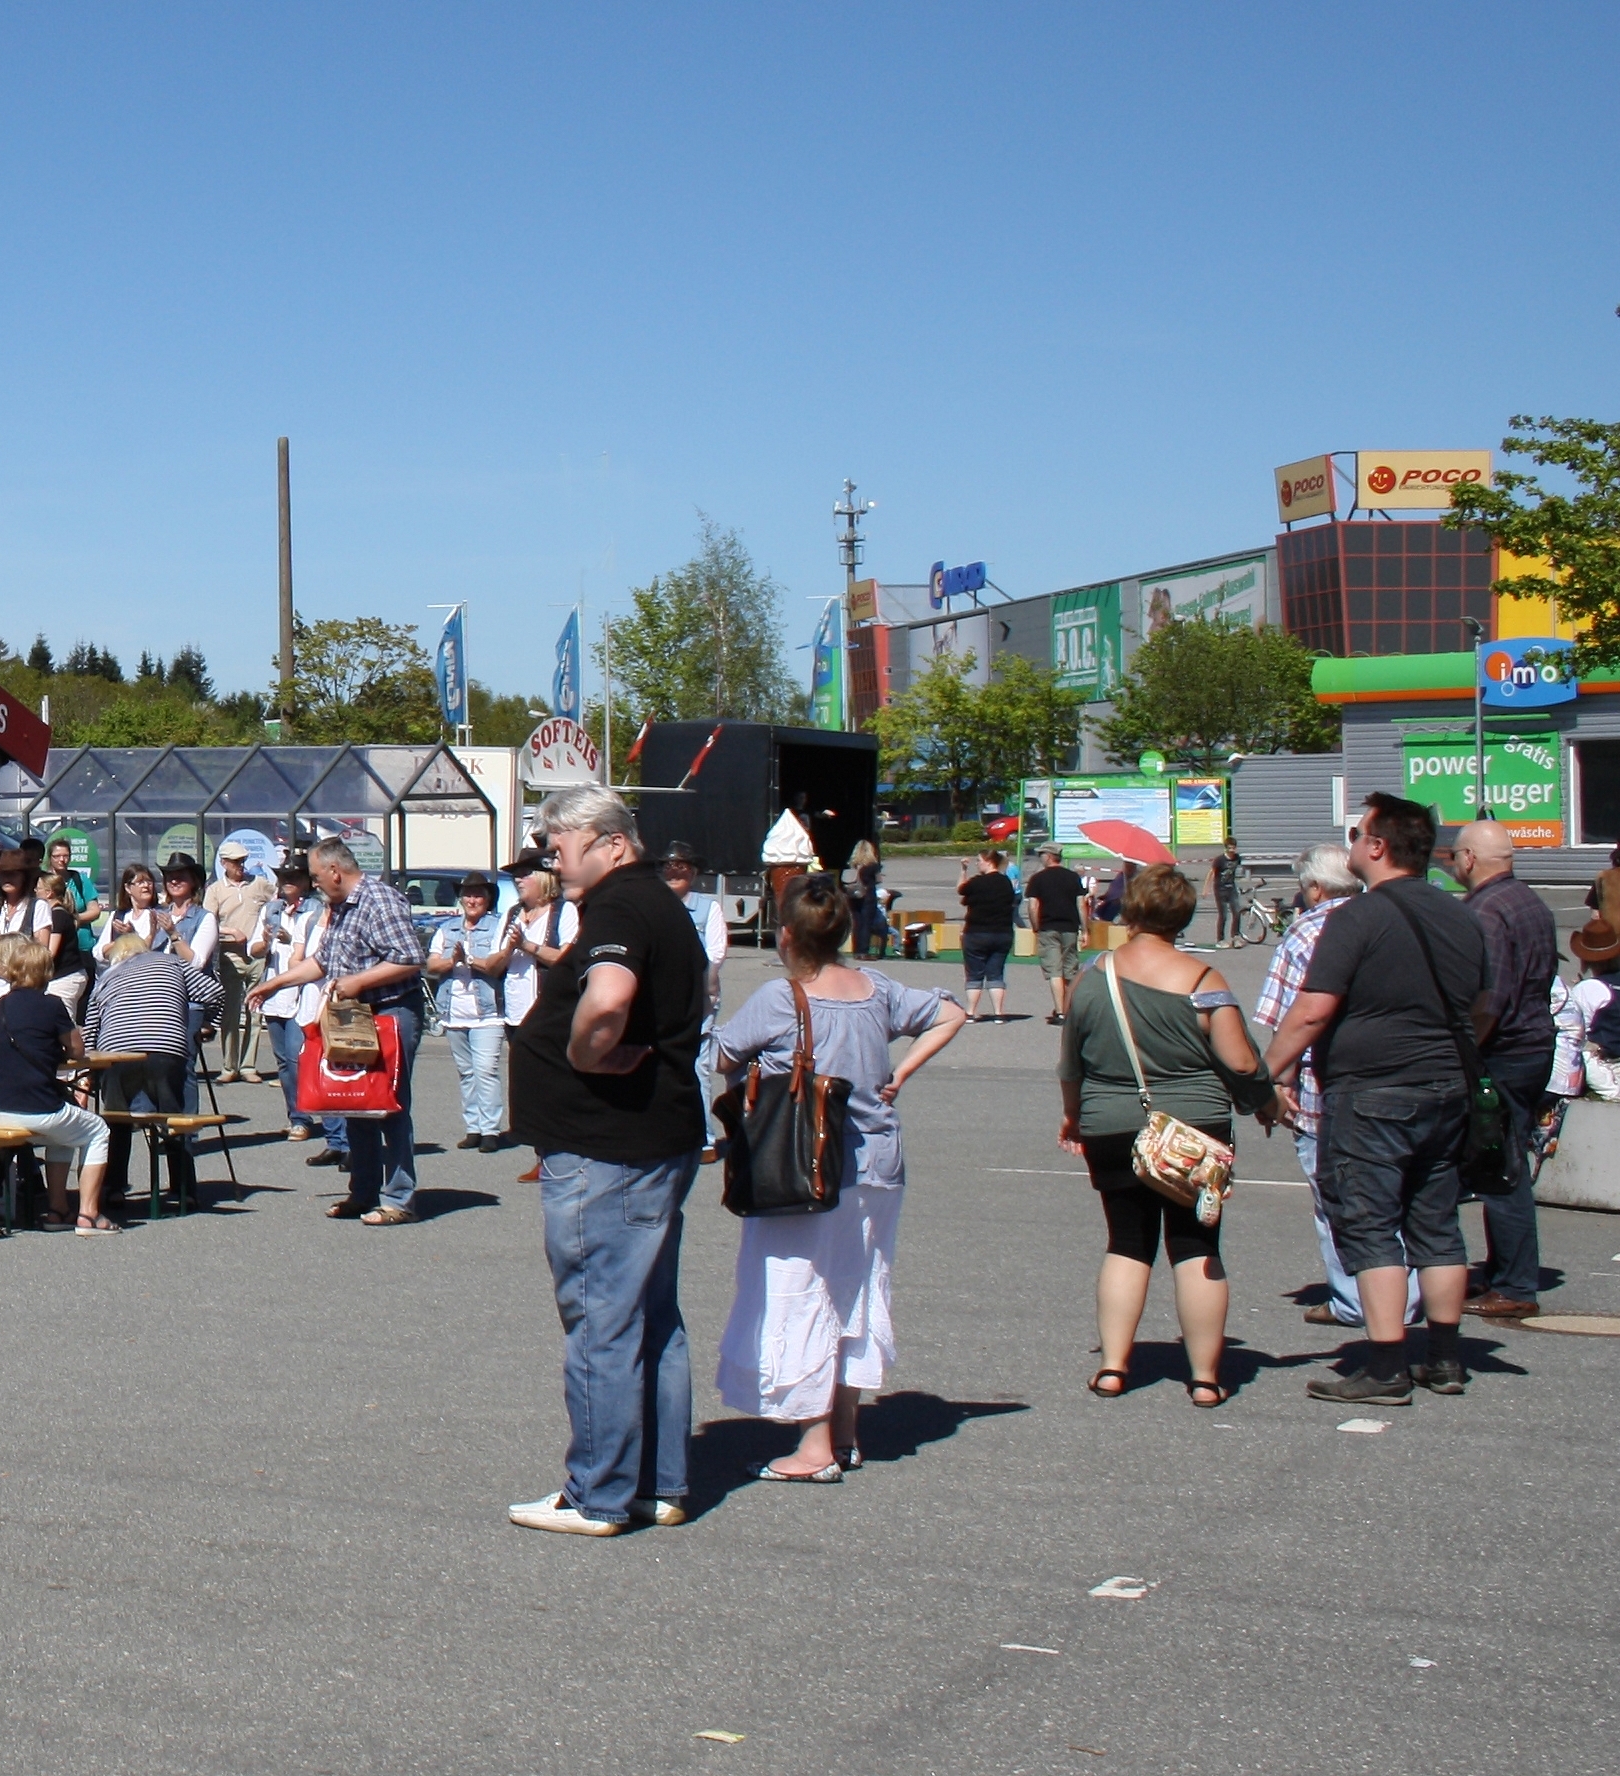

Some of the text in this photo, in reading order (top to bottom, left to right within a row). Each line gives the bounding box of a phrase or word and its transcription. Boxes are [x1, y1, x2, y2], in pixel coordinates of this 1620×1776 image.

[1293, 474, 1324, 497] POCO
[1400, 469, 1482, 486] POCO
[1499, 662, 1559, 685] imo
[531, 720, 598, 772] SOFT EIS
[1504, 735, 1555, 770] gratis
[1409, 755, 1492, 784] power
